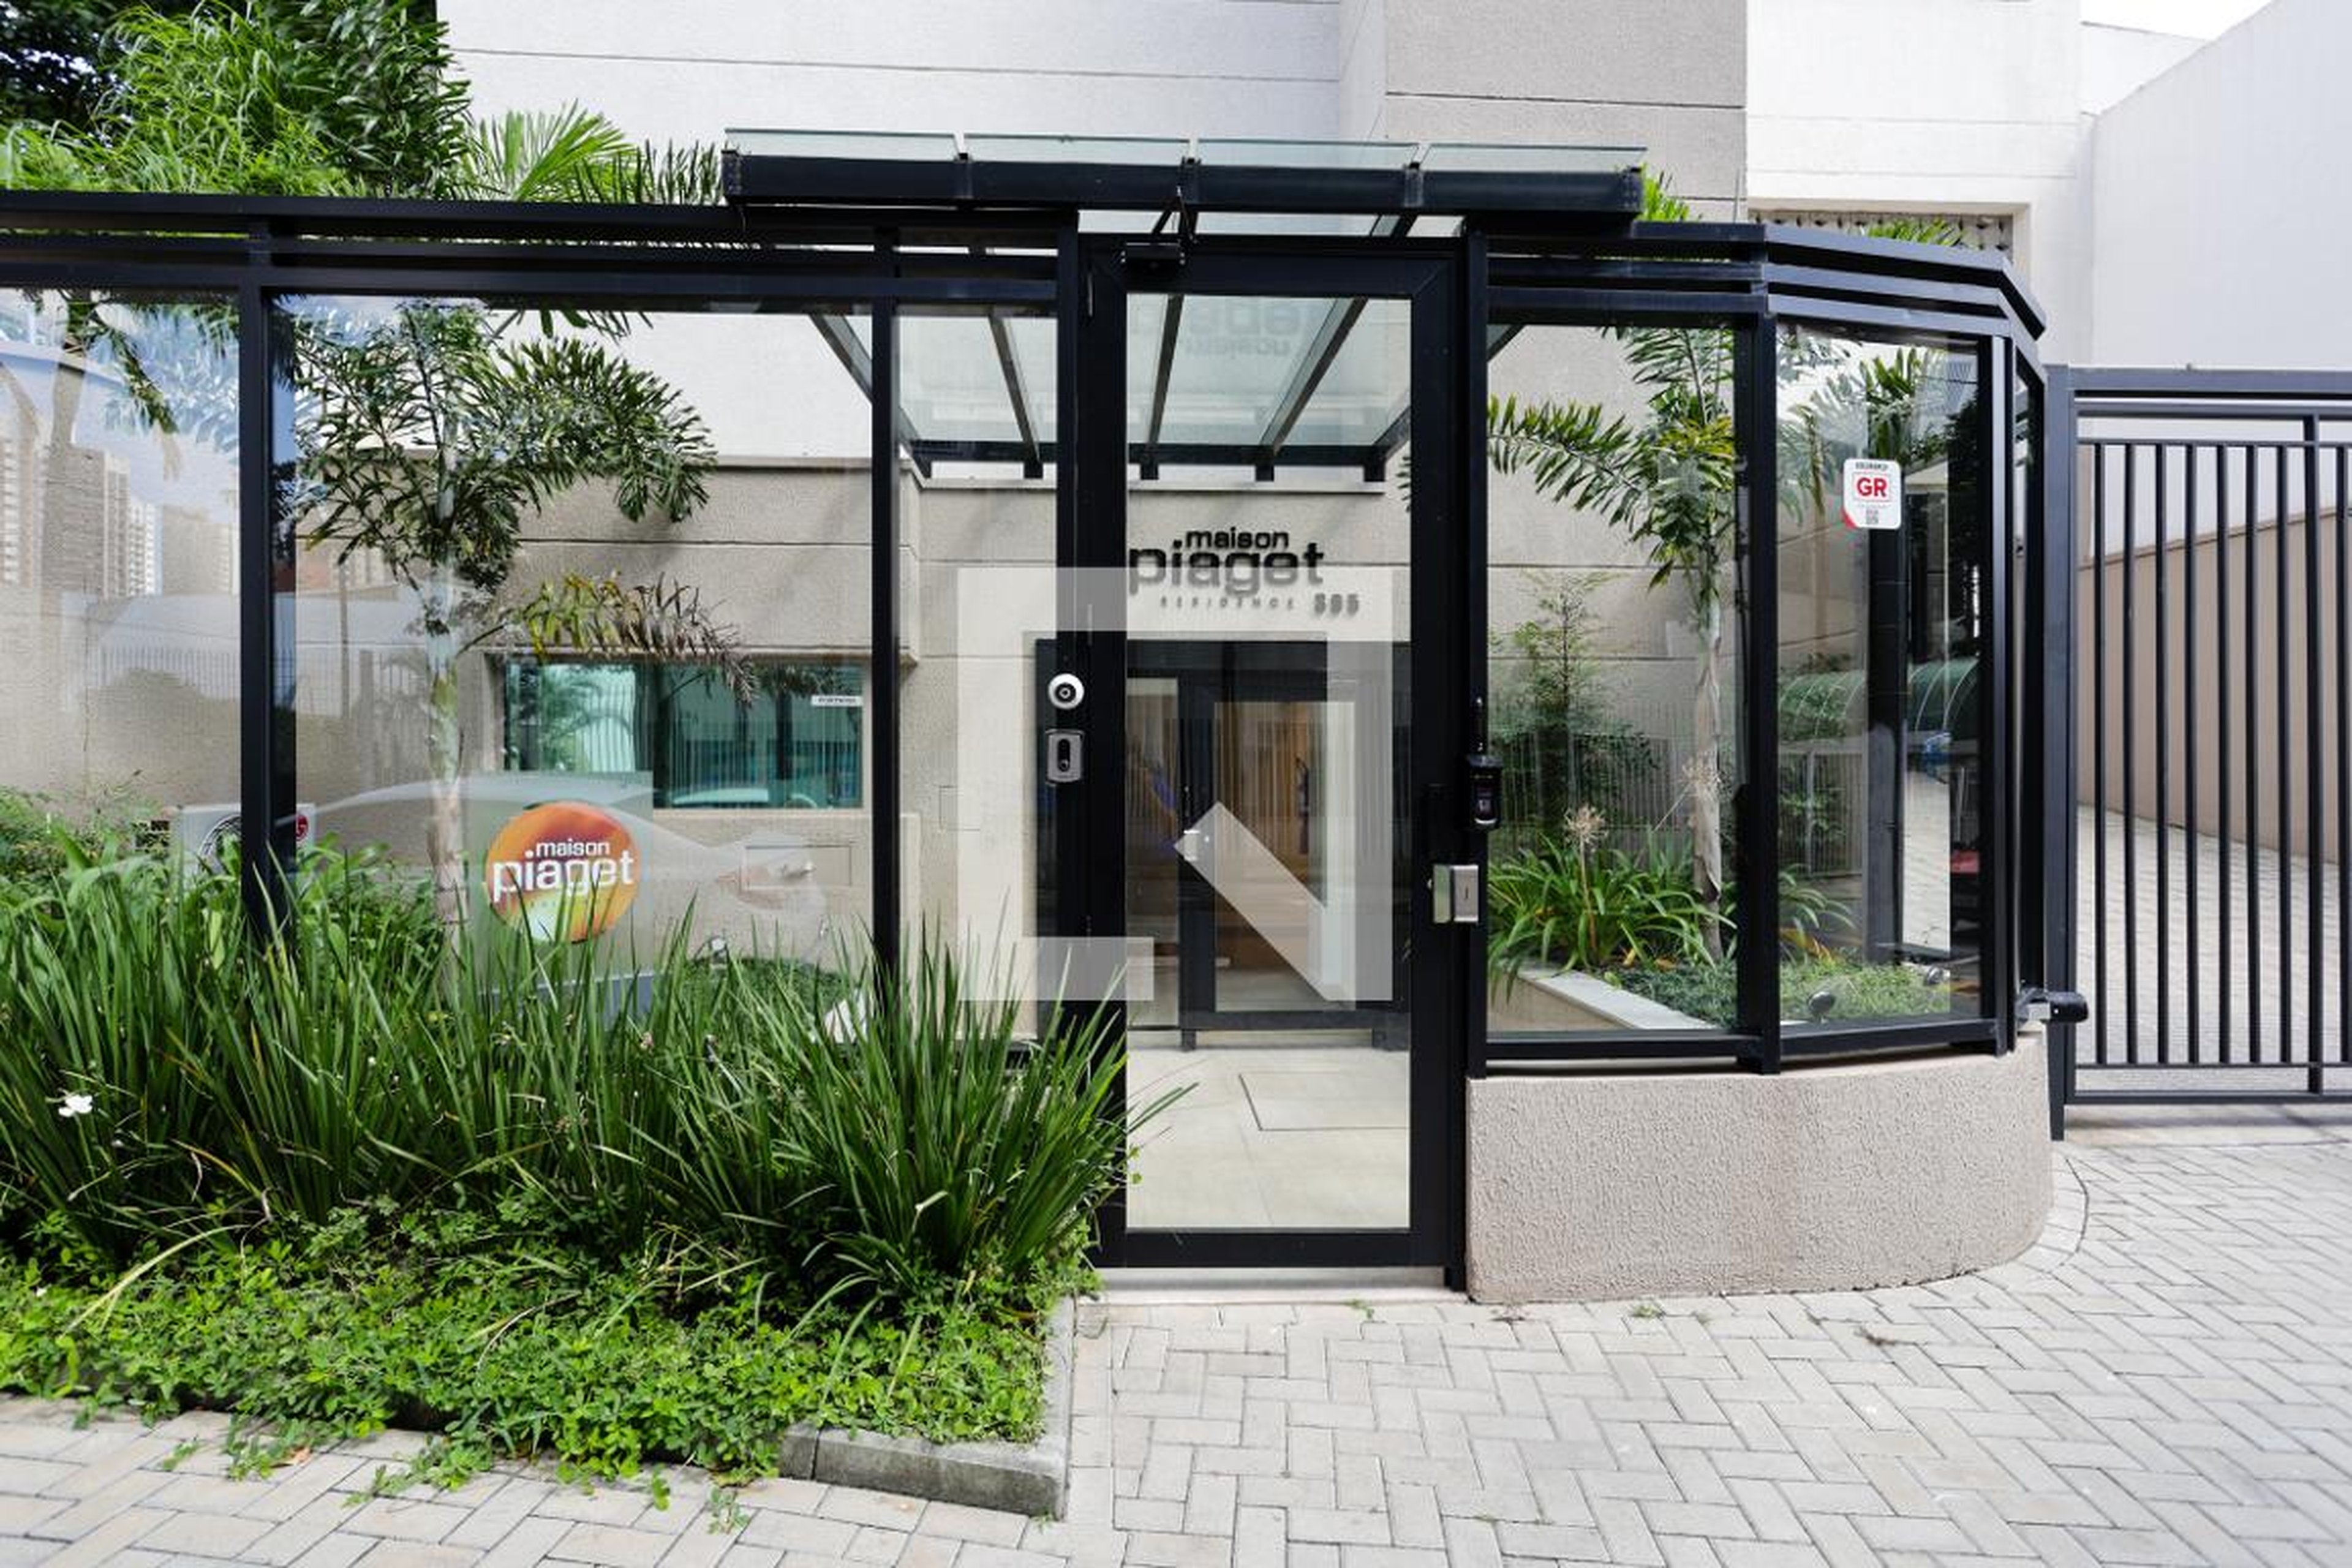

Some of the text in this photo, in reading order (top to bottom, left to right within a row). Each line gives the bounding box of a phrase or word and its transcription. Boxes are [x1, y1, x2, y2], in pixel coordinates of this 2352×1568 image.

[1857, 477, 1887, 497] GR
[1186, 527, 1289, 549] maison
[1128, 540, 1324, 595] piaget
[536, 838, 609, 857] maison
[492, 850, 635, 903] piaget
